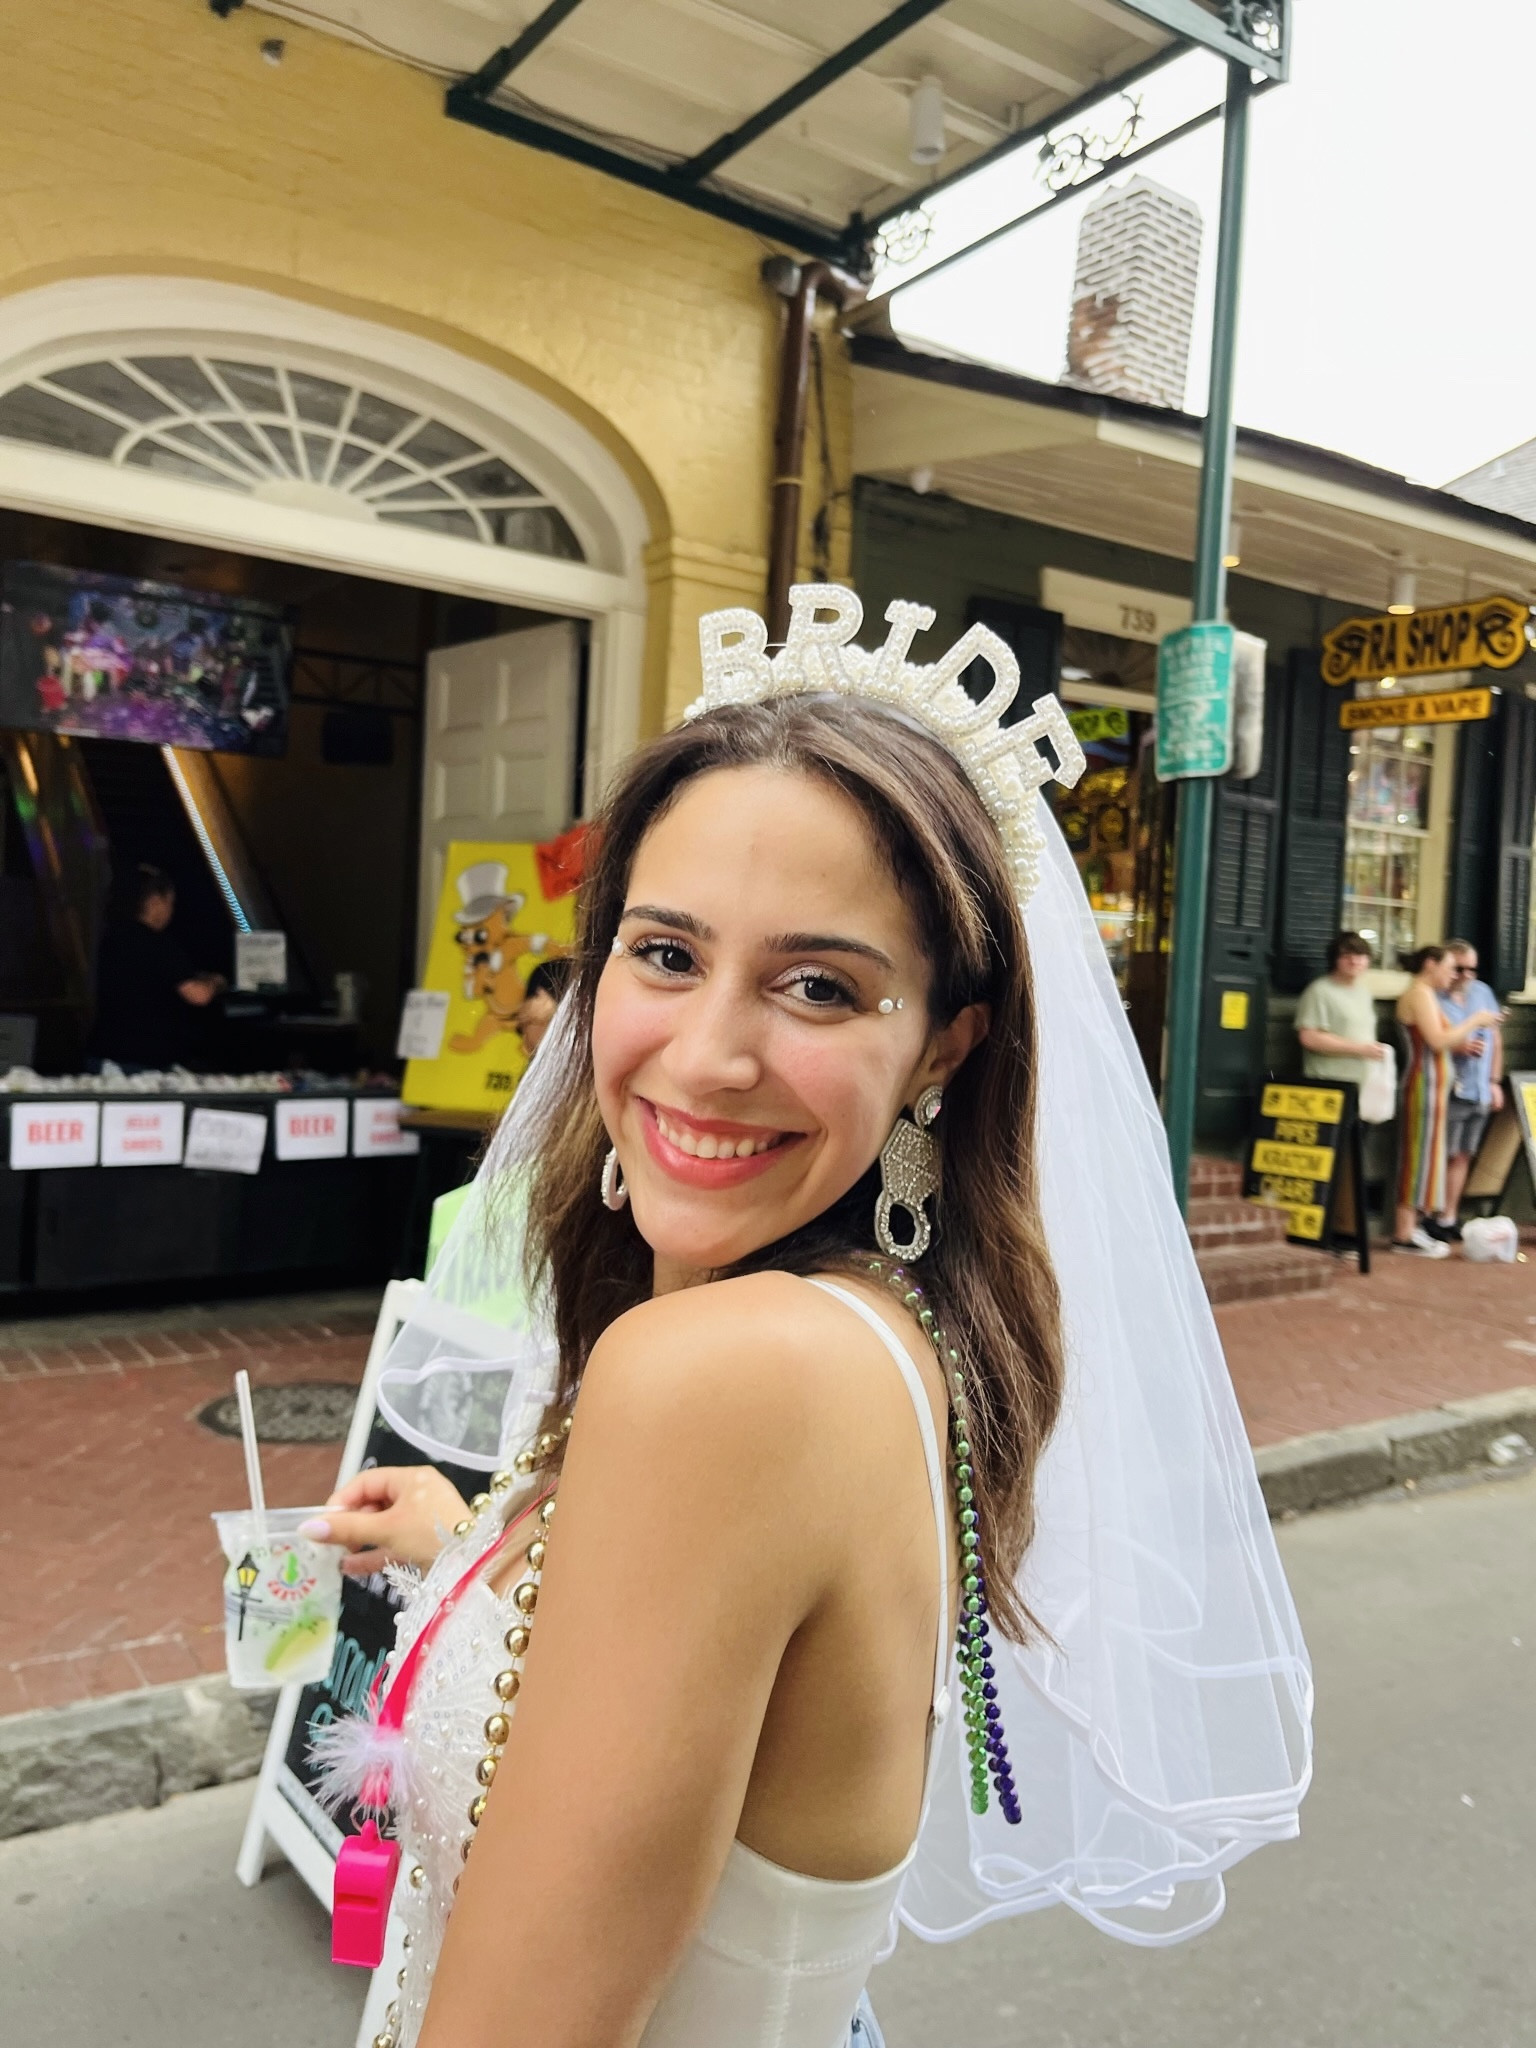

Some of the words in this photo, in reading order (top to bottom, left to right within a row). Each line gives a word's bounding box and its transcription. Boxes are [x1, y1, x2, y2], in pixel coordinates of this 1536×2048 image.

[1119, 604, 1157, 634] 739
[1369, 622, 1397, 670] RA
[1406, 611, 1471, 667] SHOP
[699, 583, 1087, 798] BRIDE
[1348, 703, 1409, 721] SMOKE
[1433, 696, 1481, 715] VAPE
[27, 1119, 84, 1144] BEER
[289, 1115, 335, 1137] BEER
